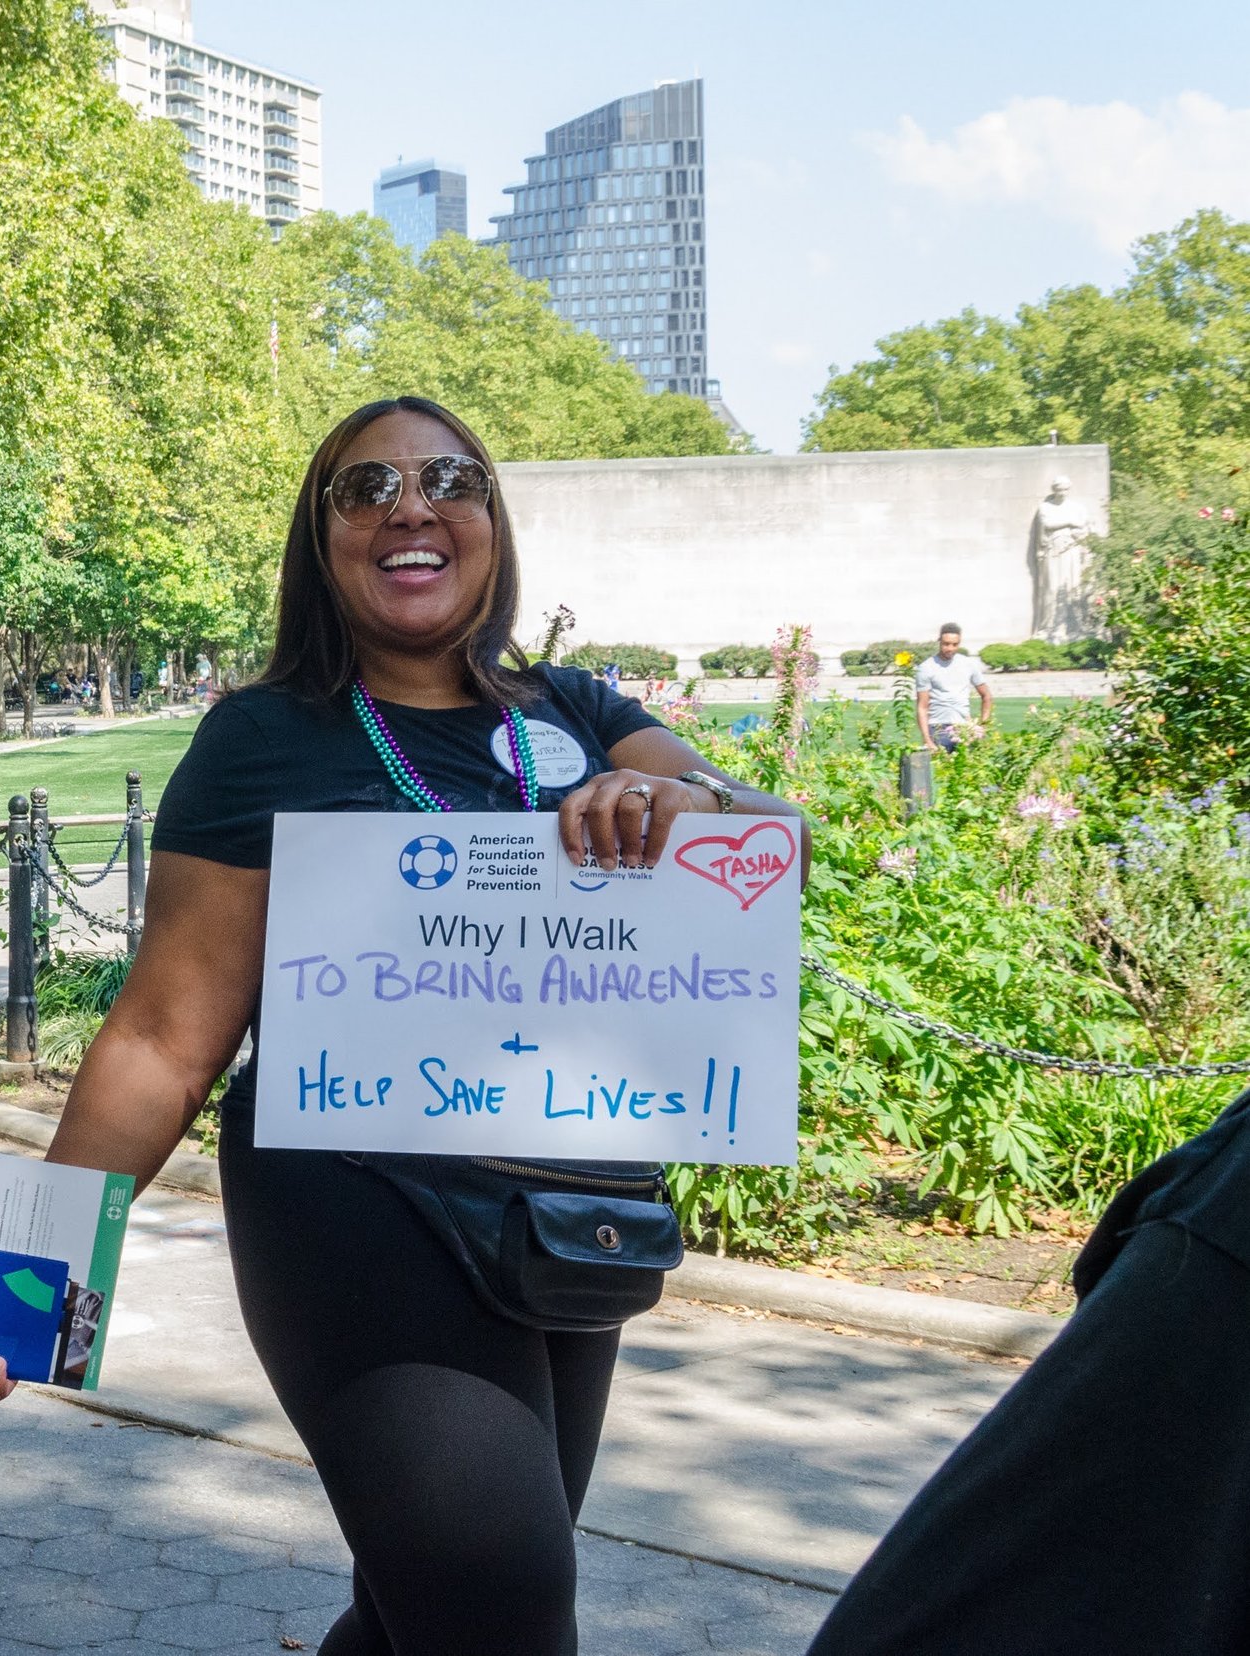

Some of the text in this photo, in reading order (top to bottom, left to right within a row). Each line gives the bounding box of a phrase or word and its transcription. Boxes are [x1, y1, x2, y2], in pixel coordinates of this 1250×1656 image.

[469, 833, 534, 845] American
[469, 849, 545, 860] Foundation
[467, 864, 538, 876] for Suicide
[709, 852, 785, 882] TASHA
[578, 870, 653, 880] Community Walks
[466, 879, 541, 891] Prevention
[419, 914, 638, 957] Why I Walk
[279, 952, 778, 1006] TO BRING AWARENESS
[299, 1050, 393, 1113] HELP
[419, 1057, 506, 1117] SAVE
